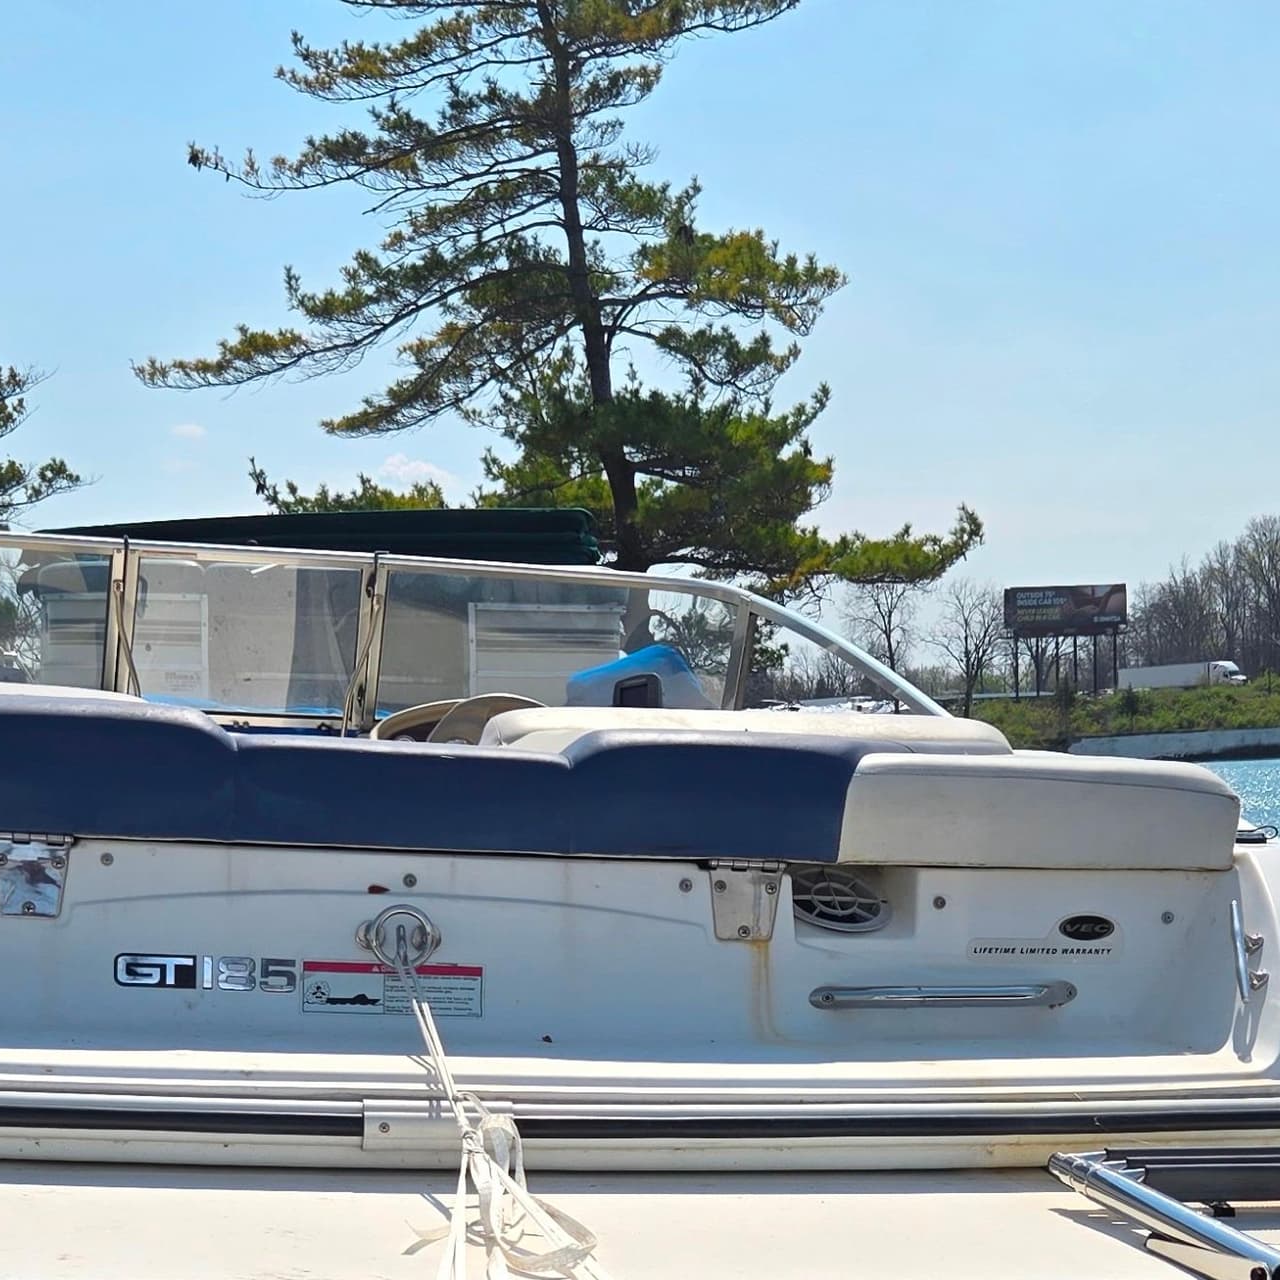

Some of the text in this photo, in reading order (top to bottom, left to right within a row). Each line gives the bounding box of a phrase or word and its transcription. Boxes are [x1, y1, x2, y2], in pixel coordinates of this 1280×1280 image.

[1065, 923, 1109, 933] VEC
[973, 947, 1112, 955] LIFETIME LIMITED WARRANTY
[116, 954, 195, 986] GT
